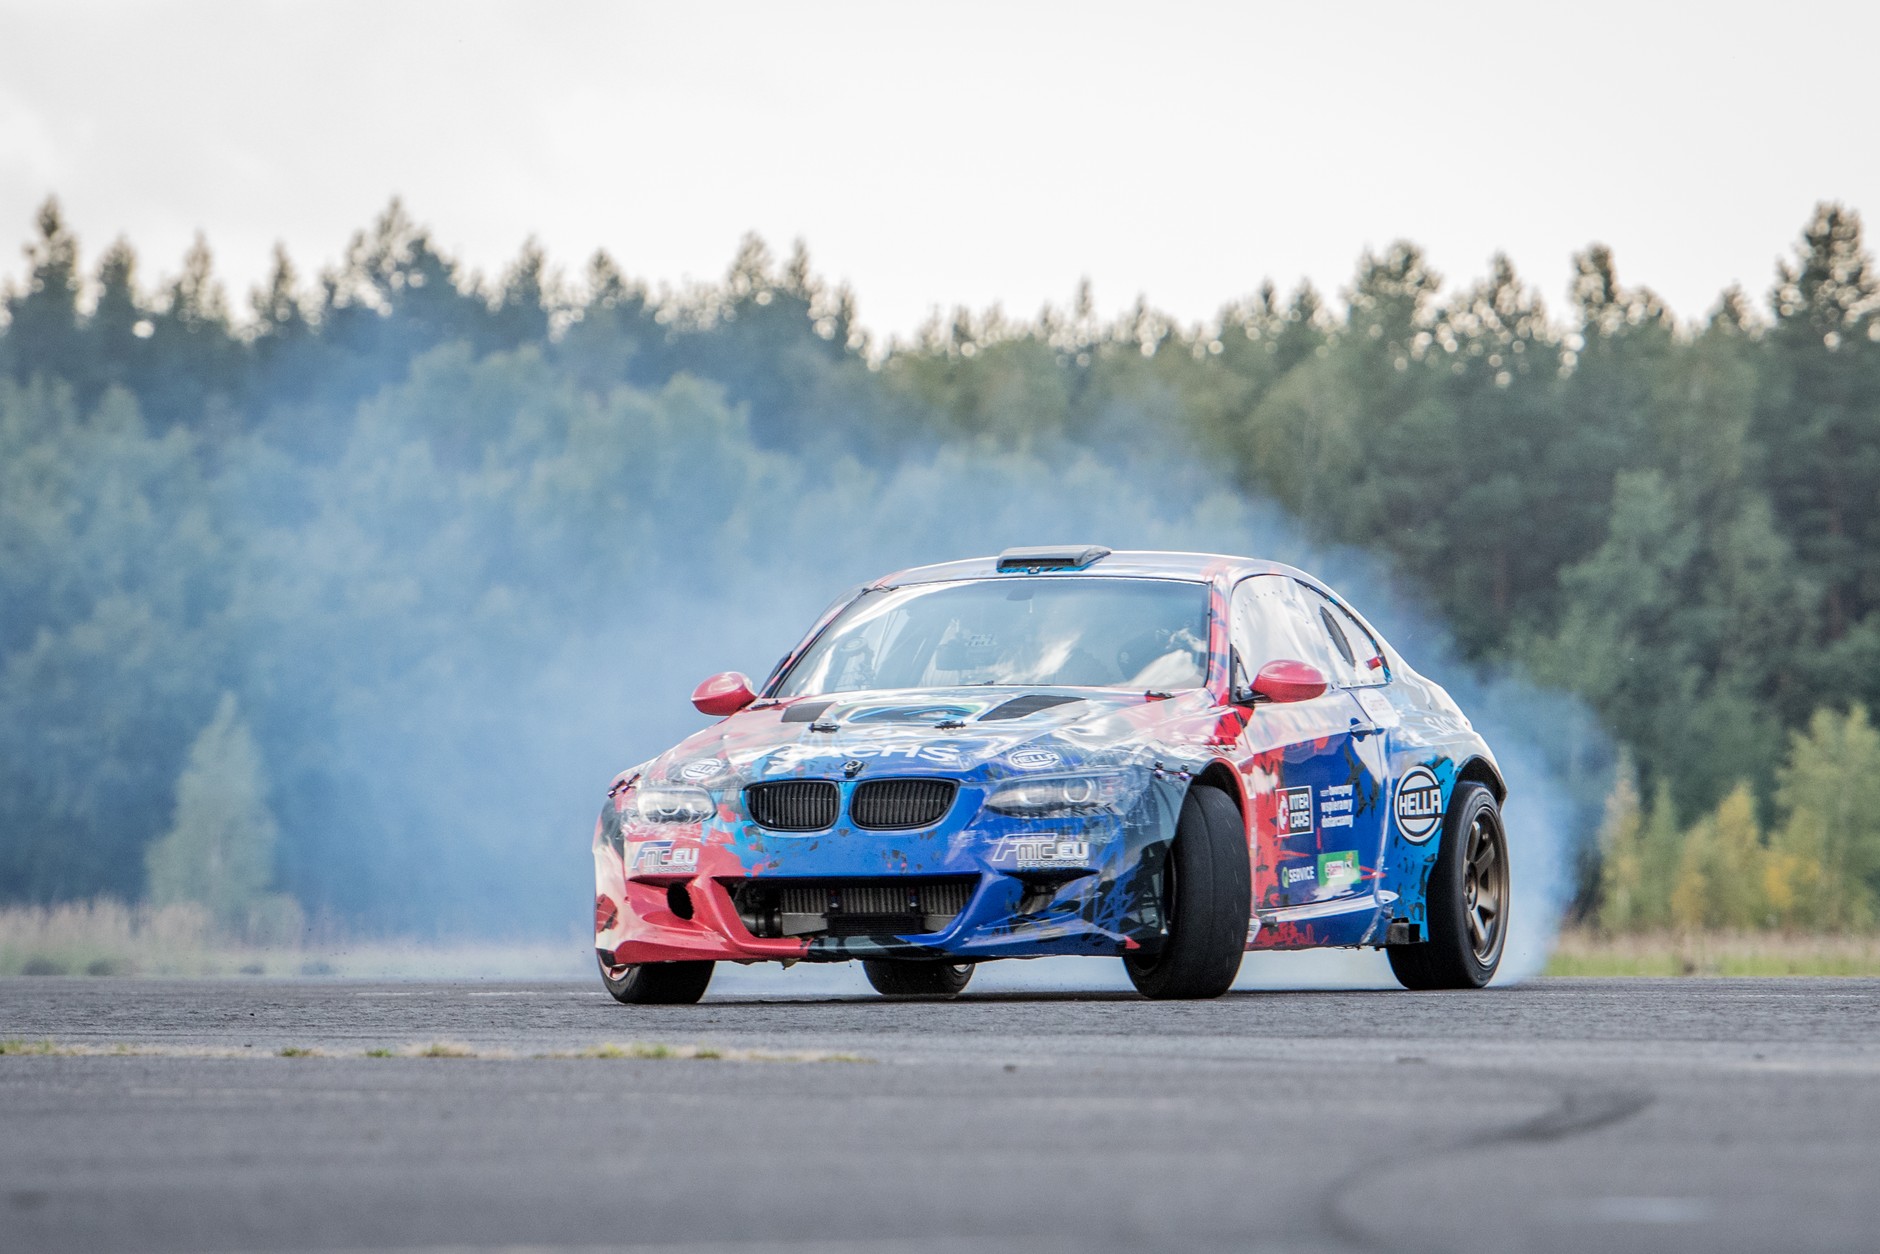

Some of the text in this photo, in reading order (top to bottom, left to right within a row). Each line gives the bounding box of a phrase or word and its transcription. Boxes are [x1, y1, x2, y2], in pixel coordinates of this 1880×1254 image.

[764, 743, 961, 775] SACHS
[1289, 793, 1309, 810] INTER
[1399, 788, 1442, 816] HELLA
[1290, 810, 1310, 828] CARS
[1288, 865, 1315, 883] SERVICE
